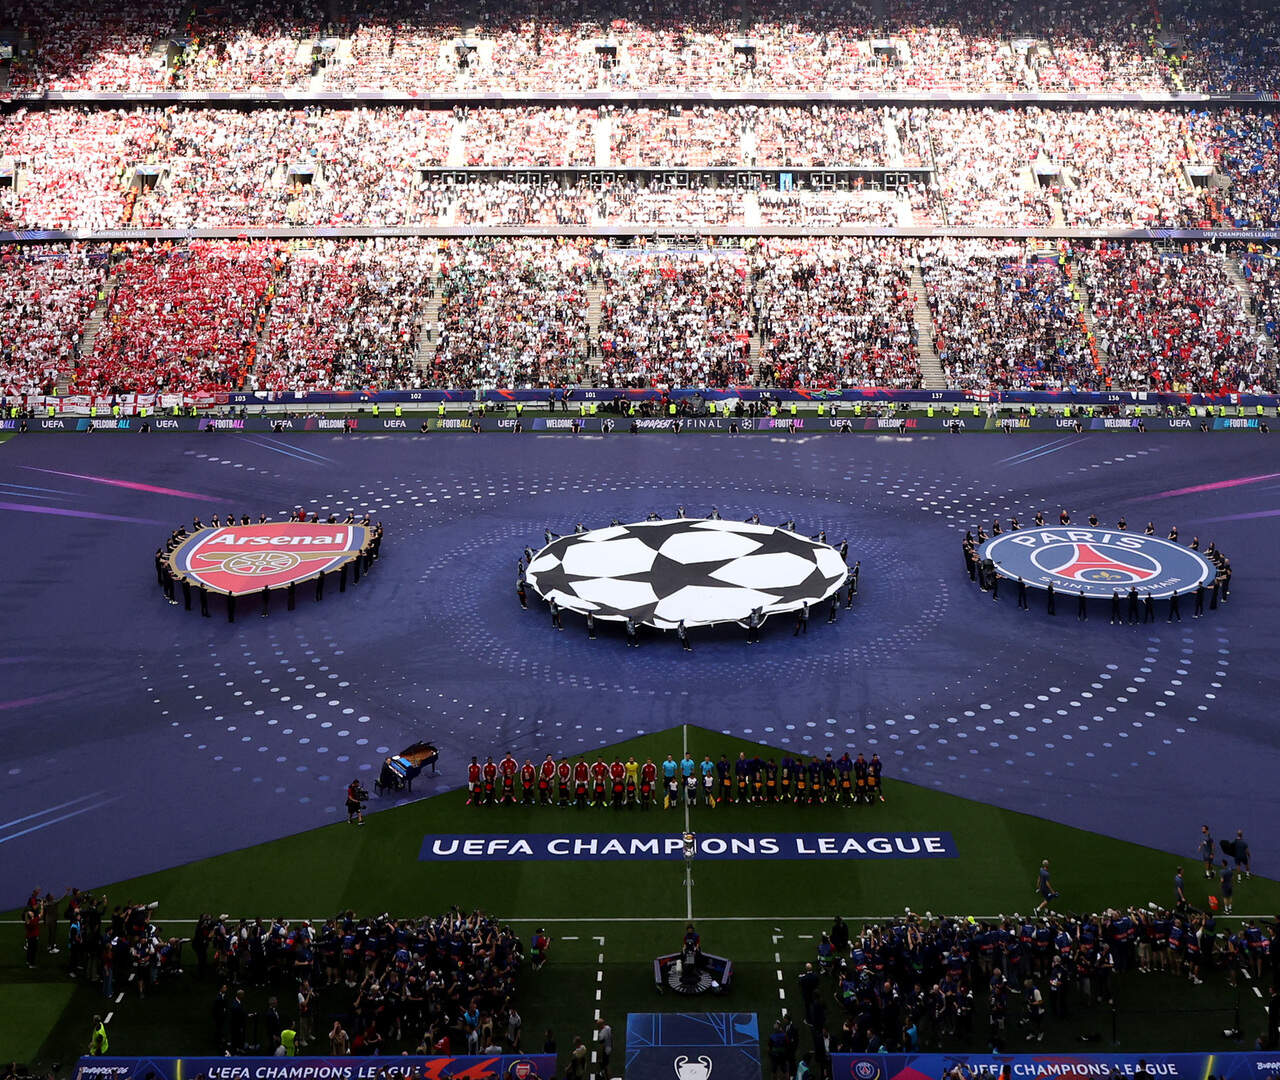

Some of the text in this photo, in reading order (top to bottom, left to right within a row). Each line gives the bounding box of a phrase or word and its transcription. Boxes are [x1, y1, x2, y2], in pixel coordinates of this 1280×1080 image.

[1219, 231, 1253, 239] CHAMPIONS
[41, 420, 64, 428] UEFA
[118, 420, 130, 428] ALL
[156, 420, 179, 428] UEFA
[318, 419, 345, 428] WELCOME
[384, 420, 406, 428] UEFA
[436, 419, 472, 428] #FOOTBALL
[546, 419, 573, 428] WELCOME
[687, 420, 722, 428] FINAL
[829, 420, 852, 428] UEFA
[905, 419, 917, 428] ALL
[1104, 419, 1130, 428] WELCOME
[1169, 420, 1191, 428] UEFA
[1224, 419, 1259, 428] #FOOTBALL
[208, 532, 345, 546] Arsenal
[1011, 530, 1146, 549] PARIS
[1038, 575, 1095, 591] SAINT
[432, 837, 947, 856] UEFA CHAMPONS LEAGUE
[208, 1066, 251, 1080] UEFA
[256, 1066, 353, 1080] CHAMPIONS
[1014, 1063, 1110, 1076] CHAMPIONS
